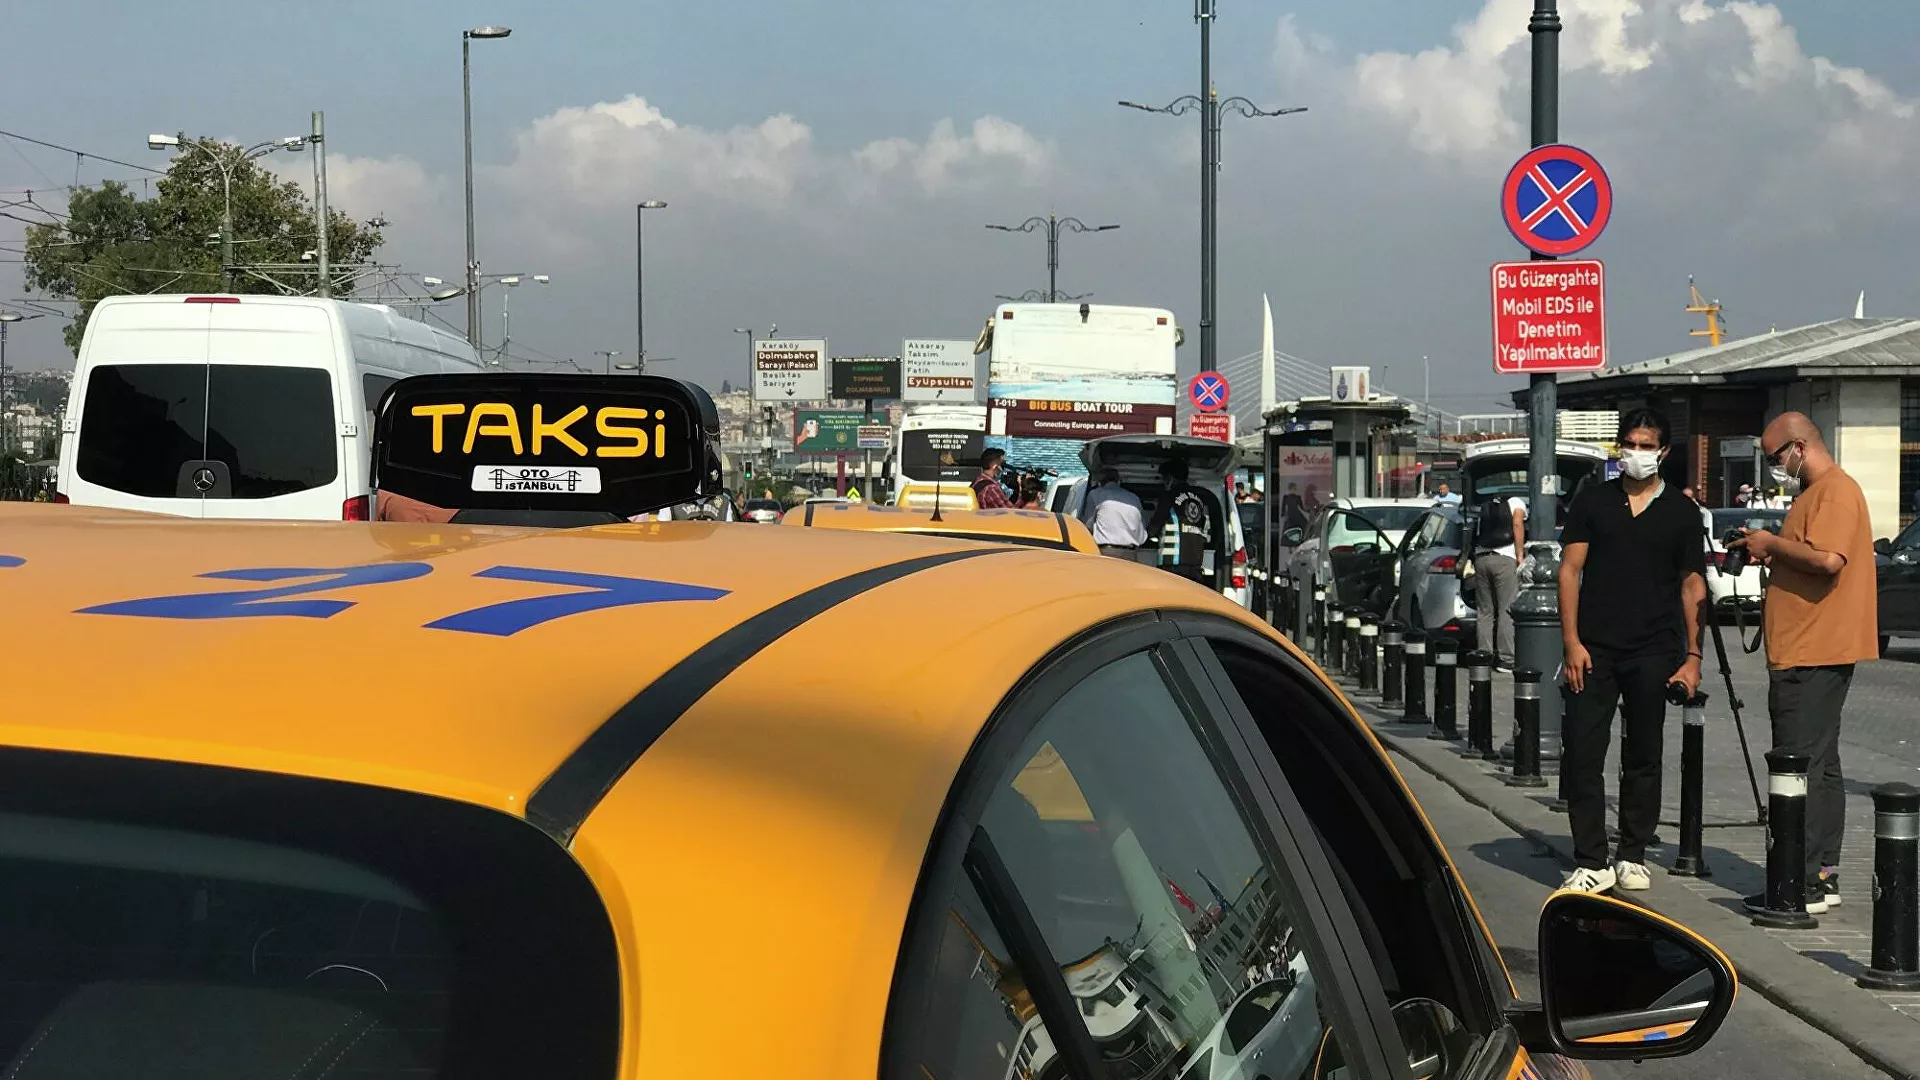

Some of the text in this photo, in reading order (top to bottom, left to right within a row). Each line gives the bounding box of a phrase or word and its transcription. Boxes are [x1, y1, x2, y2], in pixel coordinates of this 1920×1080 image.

[1498, 268, 1599, 291] Bu Güzergahta
[1502, 296, 1594, 316] Mobil EDS ile
[1518, 320, 1582, 338] Denetim
[908, 342, 945, 351] Aksaray
[1500, 341, 1601, 366] Yapılmaktadır
[759, 352, 815, 360] Dolmabahçe
[1029, 400, 1133, 414] BIG BUS BOAT TOUR
[1034, 420, 1070, 430] Connecting
[1071, 421, 1095, 430] Europe
[1096, 422, 1108, 430] and
[520, 469, 550, 478] OTO
